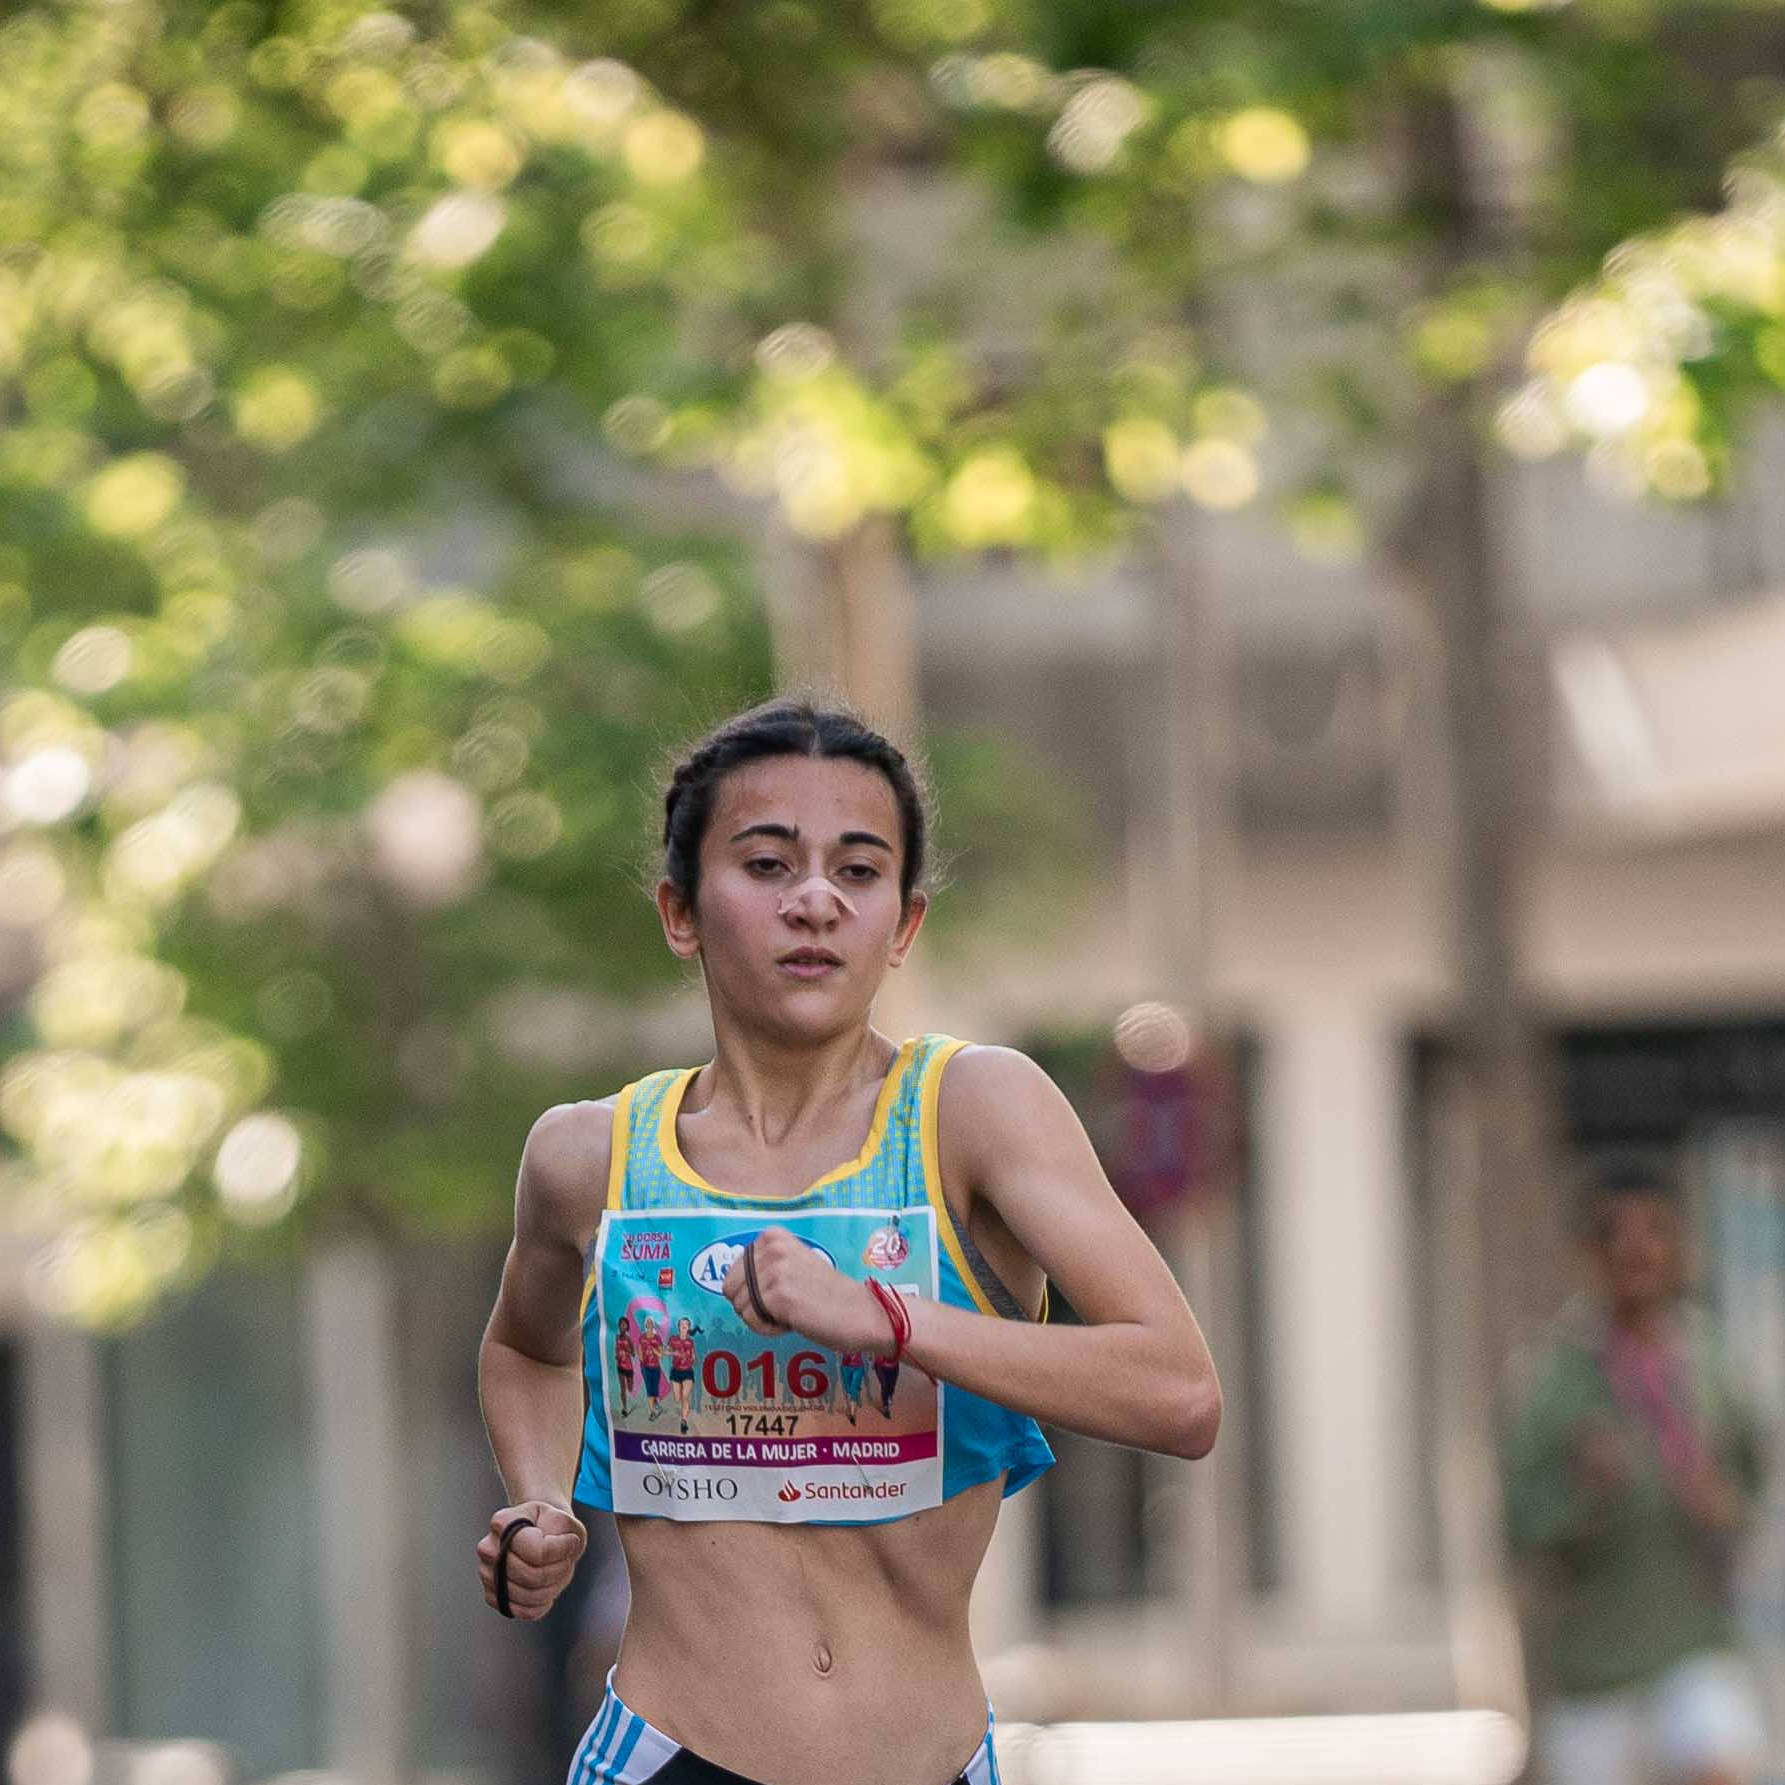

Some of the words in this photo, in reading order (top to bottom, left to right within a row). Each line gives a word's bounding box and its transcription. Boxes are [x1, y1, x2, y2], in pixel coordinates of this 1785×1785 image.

[621, 1244, 671, 1261] SUMA
[702, 1350, 830, 1399] 016
[726, 1414, 799, 1436] 17447
[641, 1439, 707, 1459] CARRERA
[712, 1443, 732, 1459] DE
[737, 1443, 757, 1460] LA
[762, 1443, 818, 1460] MUJER
[833, 1442, 900, 1458] MADRID
[643, 1474, 738, 1501] OYSHO
[805, 1481, 907, 1500] Santander
